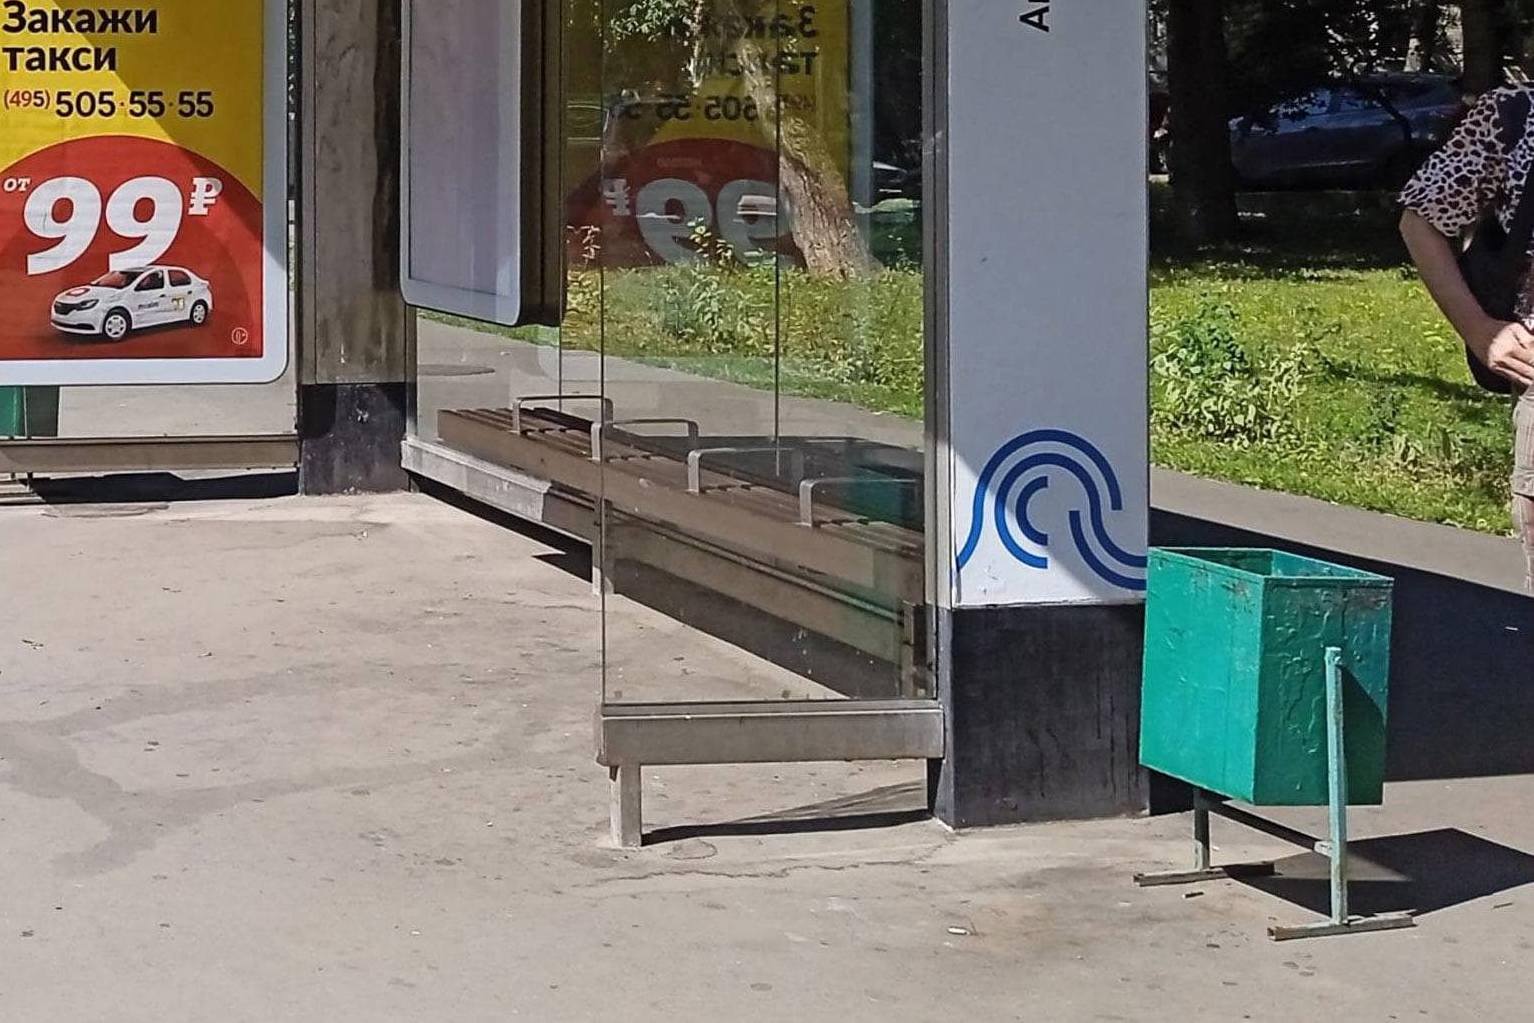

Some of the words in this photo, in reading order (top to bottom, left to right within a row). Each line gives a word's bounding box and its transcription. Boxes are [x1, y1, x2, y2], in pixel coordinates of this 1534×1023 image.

[1, 0, 158, 35] Закажи
[2, 46, 116, 72] такси
[3, 90, 50, 110] (495)
[23, 176, 183, 276] 99
